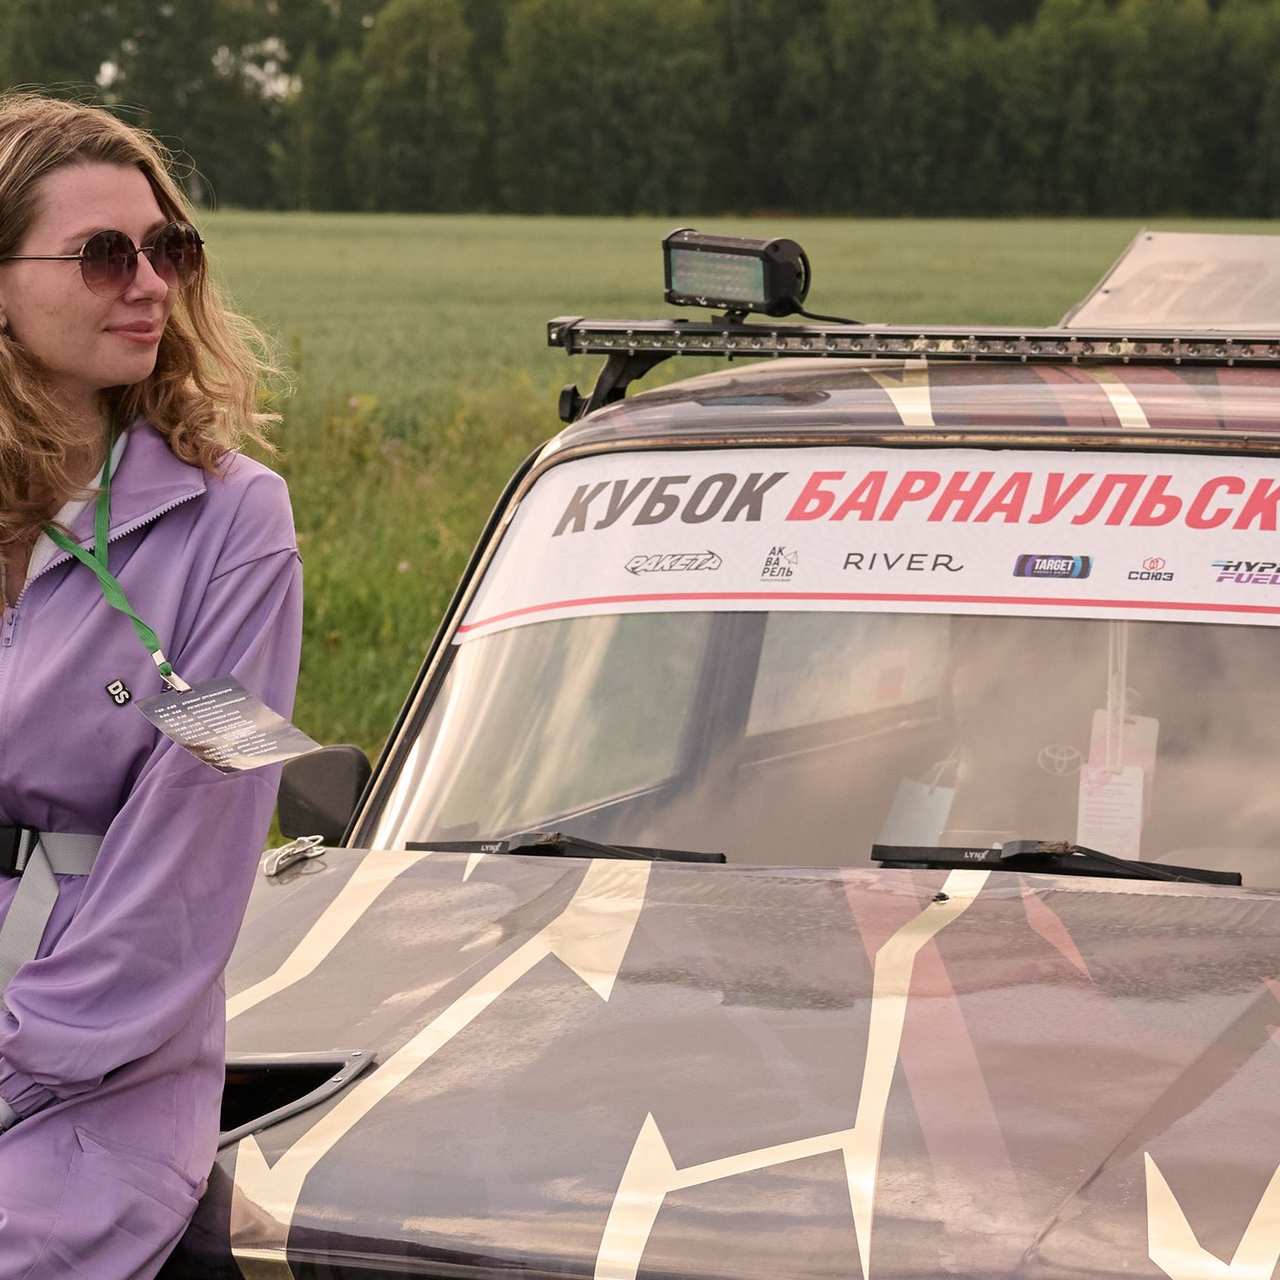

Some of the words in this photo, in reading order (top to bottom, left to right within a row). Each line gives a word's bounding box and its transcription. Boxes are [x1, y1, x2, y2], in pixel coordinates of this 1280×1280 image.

[551, 471, 789, 537] КУБОК
[784, 470, 1280, 531] БАРНАУЛЬСК
[843, 553, 964, 572] RIVER
[1034, 558, 1075, 571] TARGET
[1127, 571, 1174, 582] СОЮЗ
[107, 680, 130, 704] DS
